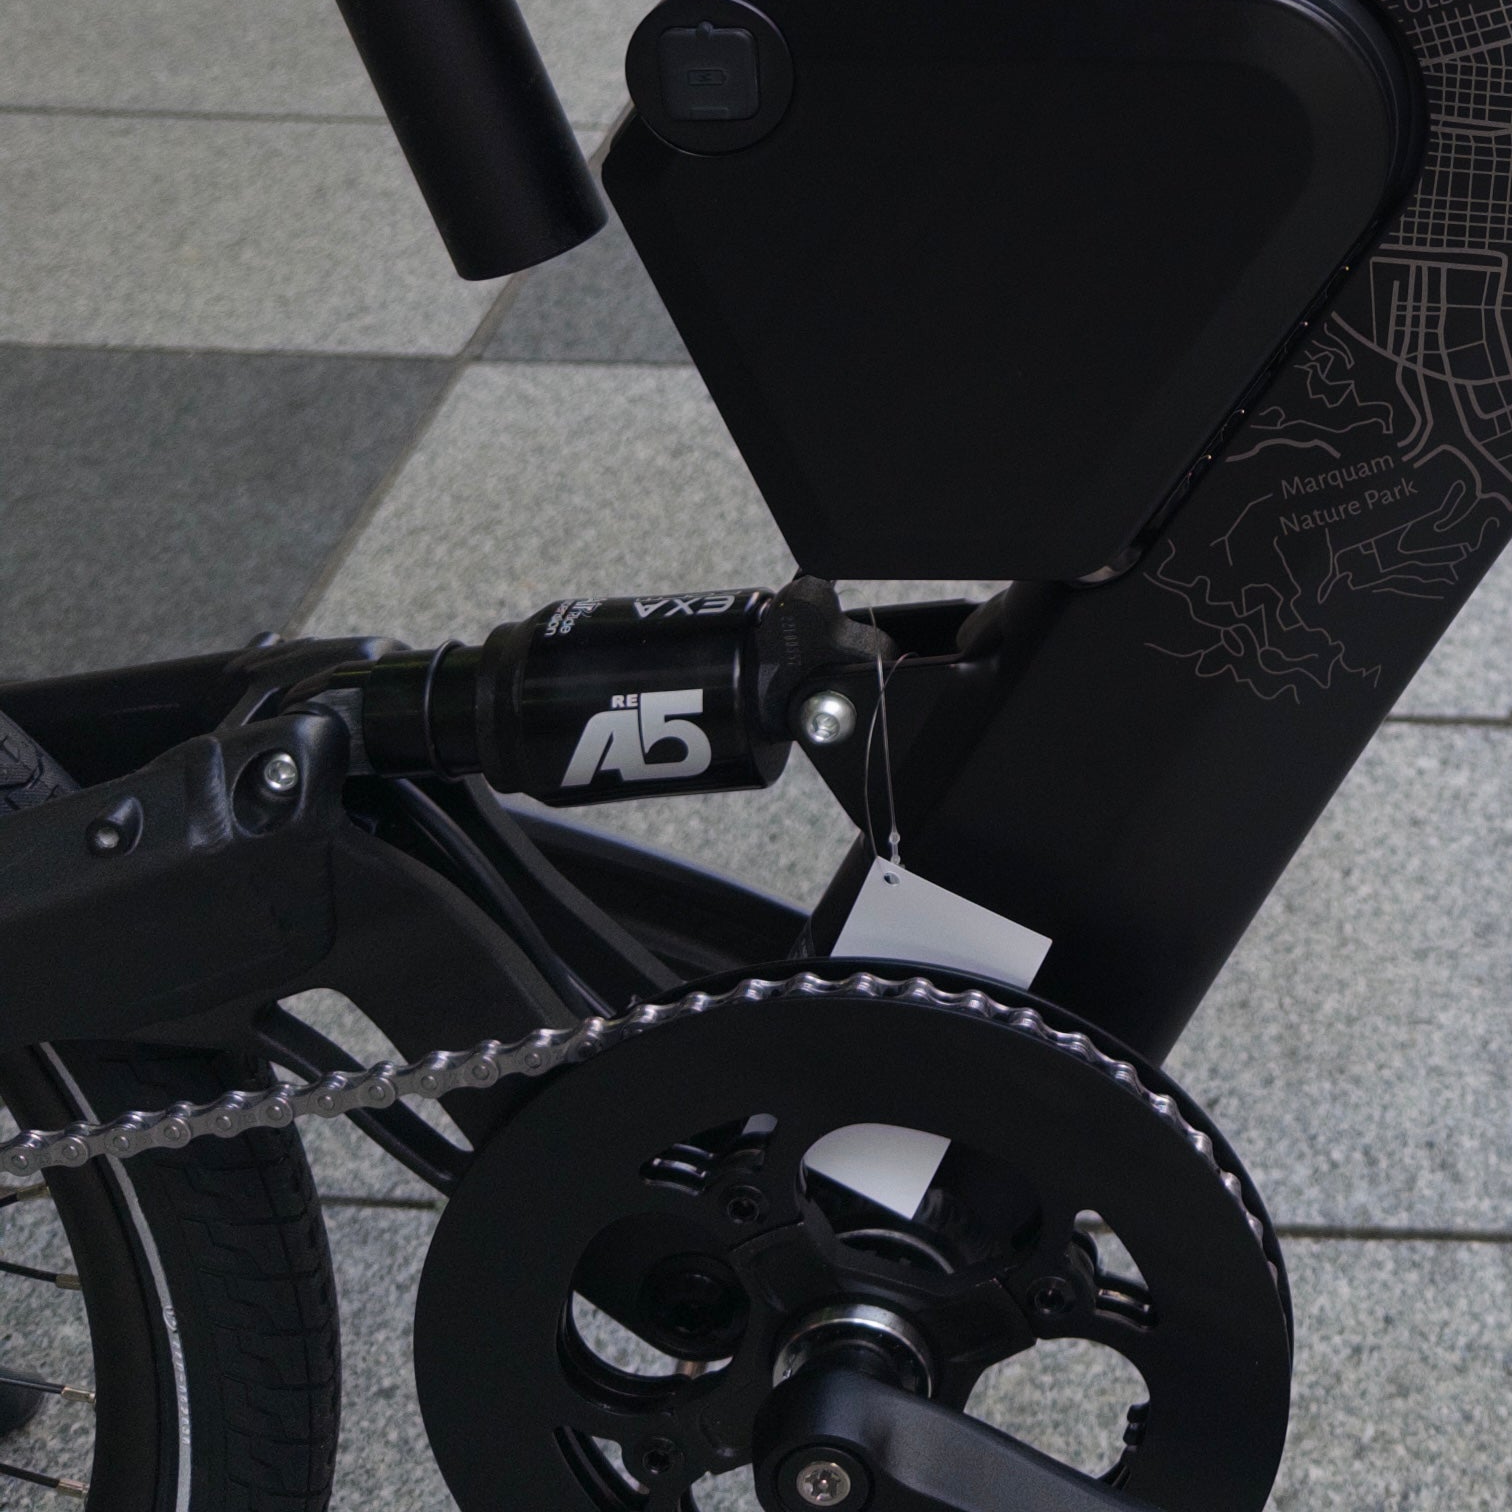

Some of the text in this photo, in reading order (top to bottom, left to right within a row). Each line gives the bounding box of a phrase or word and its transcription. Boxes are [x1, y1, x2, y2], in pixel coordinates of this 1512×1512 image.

[1281, 454, 1395, 500] Marquam
[1279, 477, 1419, 537] Nature Park
[633, 594, 737, 619] EXA
